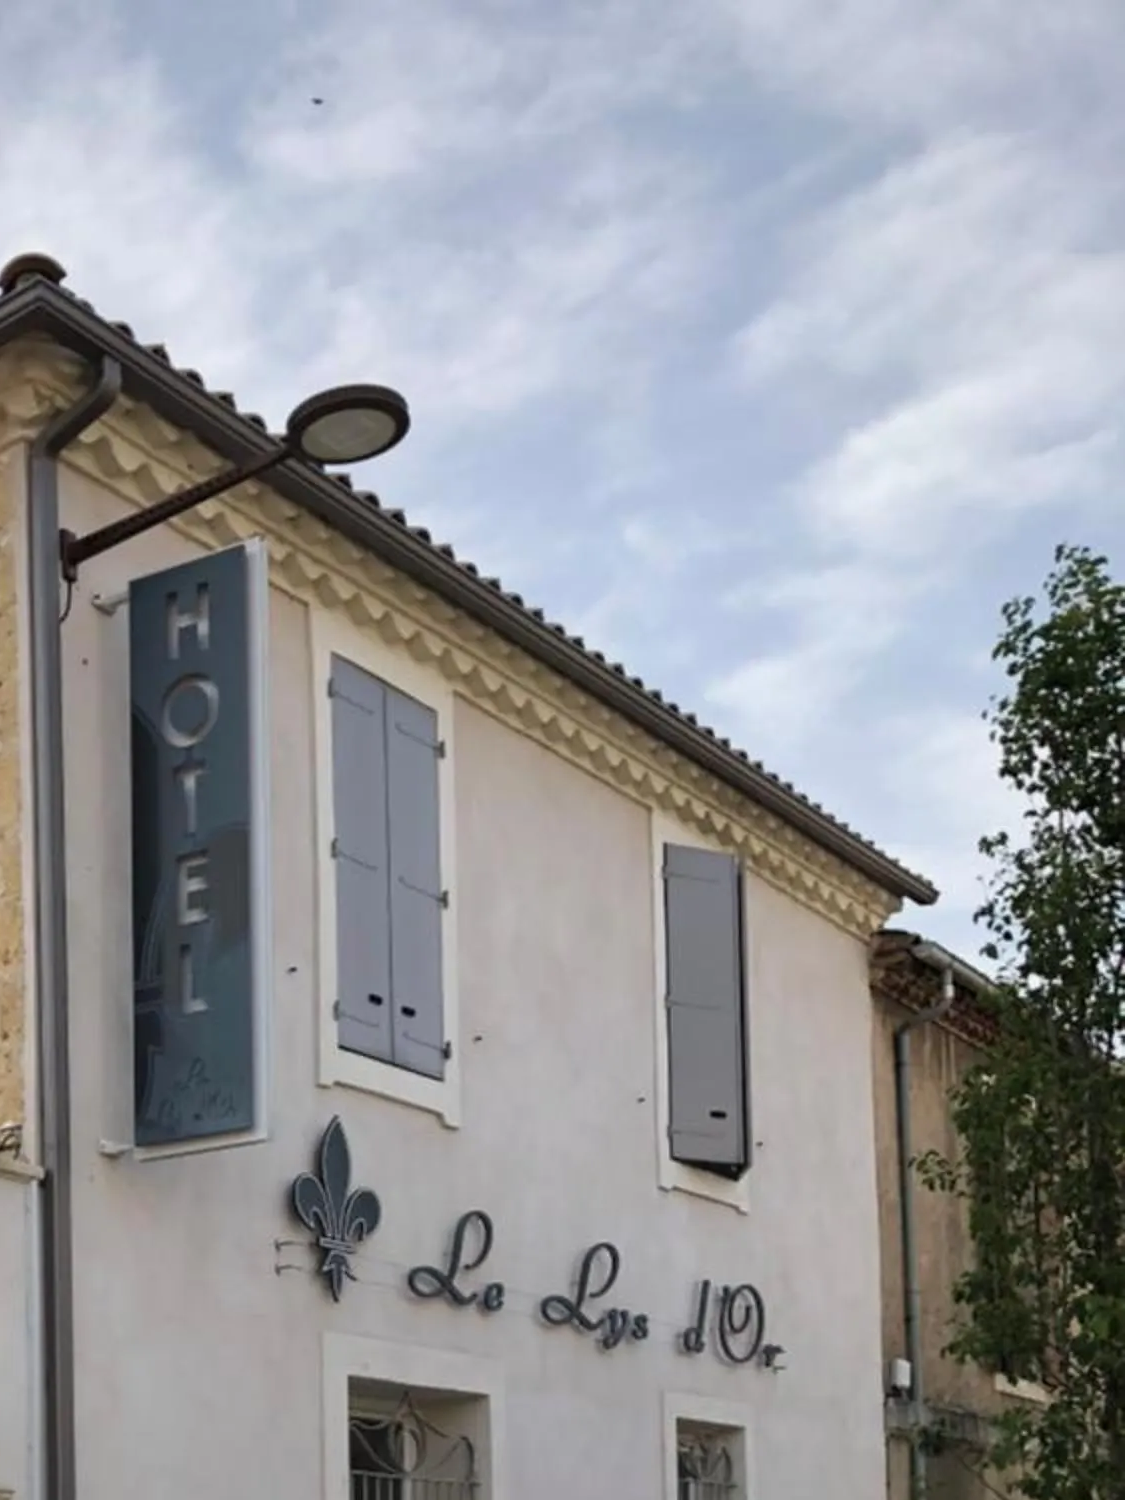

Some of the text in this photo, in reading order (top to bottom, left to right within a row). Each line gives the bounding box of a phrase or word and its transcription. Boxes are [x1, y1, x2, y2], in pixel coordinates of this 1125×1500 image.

[162, 582, 219, 1015] HOTEL
[407, 1210, 505, 1312] Le
[539, 1242, 649, 1351] Lys
